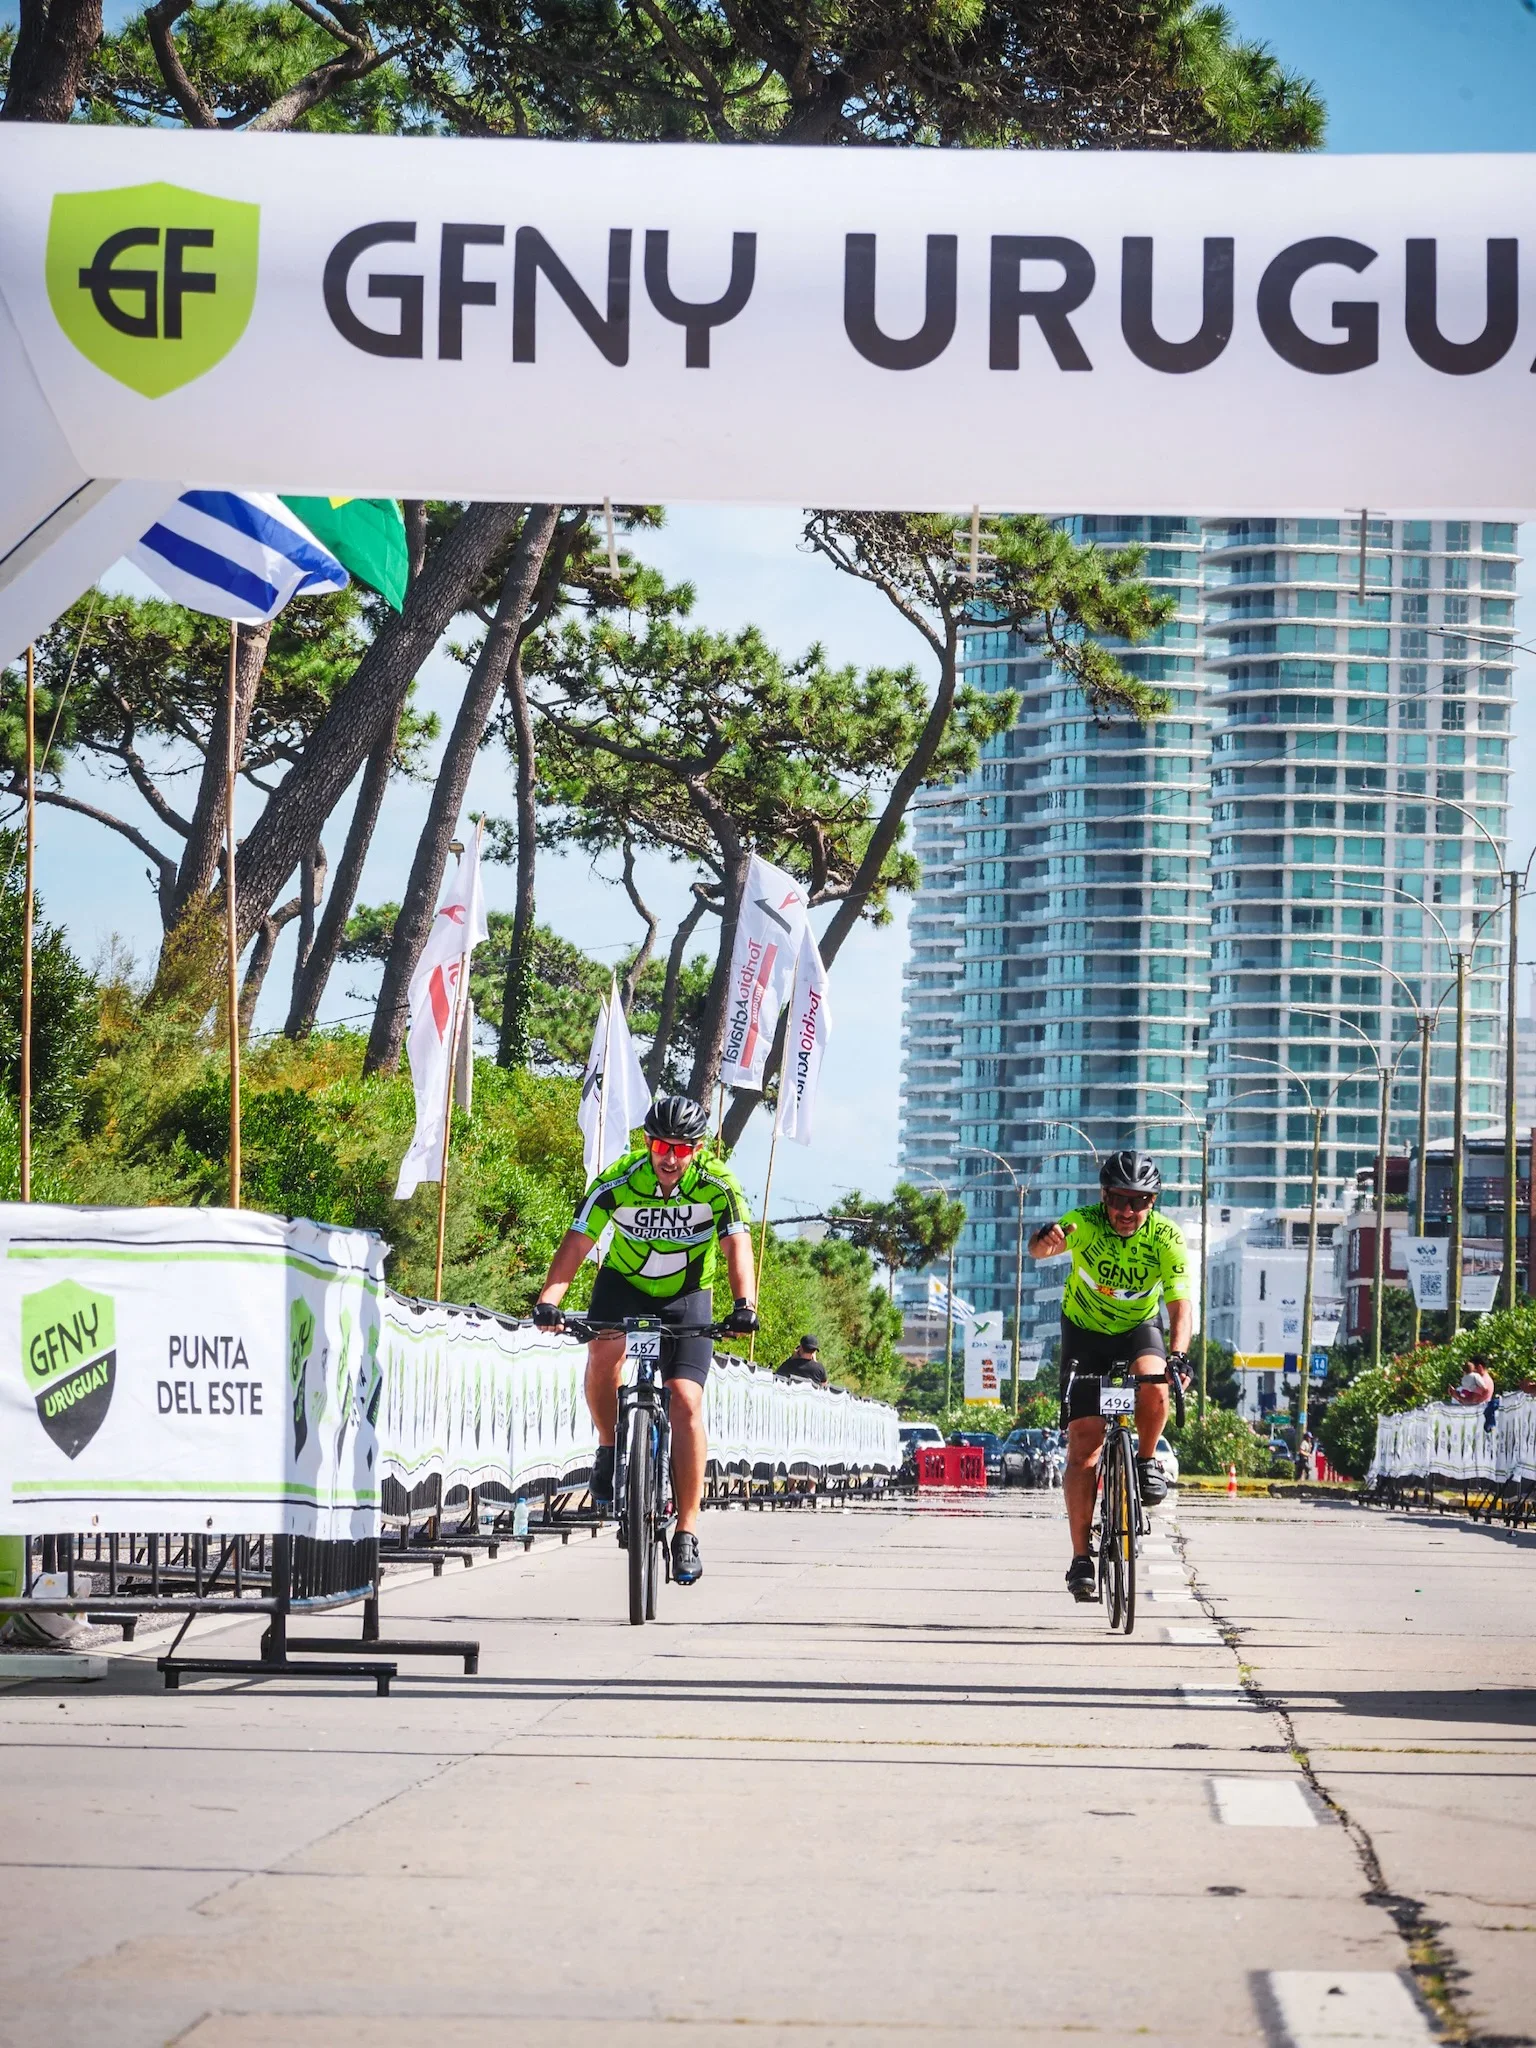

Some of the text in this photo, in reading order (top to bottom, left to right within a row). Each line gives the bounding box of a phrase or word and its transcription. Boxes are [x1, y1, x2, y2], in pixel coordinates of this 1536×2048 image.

[79, 227, 216, 339] GF
[323, 221, 1536, 375] GFNY URUGU
[632, 1226, 695, 1239] URUGUAY
[635, 1205, 692, 1228] GFNY
[1098, 1260, 1149, 1285] GFNY
[1099, 1277, 1144, 1291] URUGUAY
[30, 1303, 98, 1376] GFNY
[169, 1335, 249, 1370] PUNTA
[45, 1360, 108, 1417] URUGUAY
[157, 1381, 201, 1415] DEL
[209, 1382, 263, 1415] ESTE
[1104, 1398, 1131, 1409] 496
